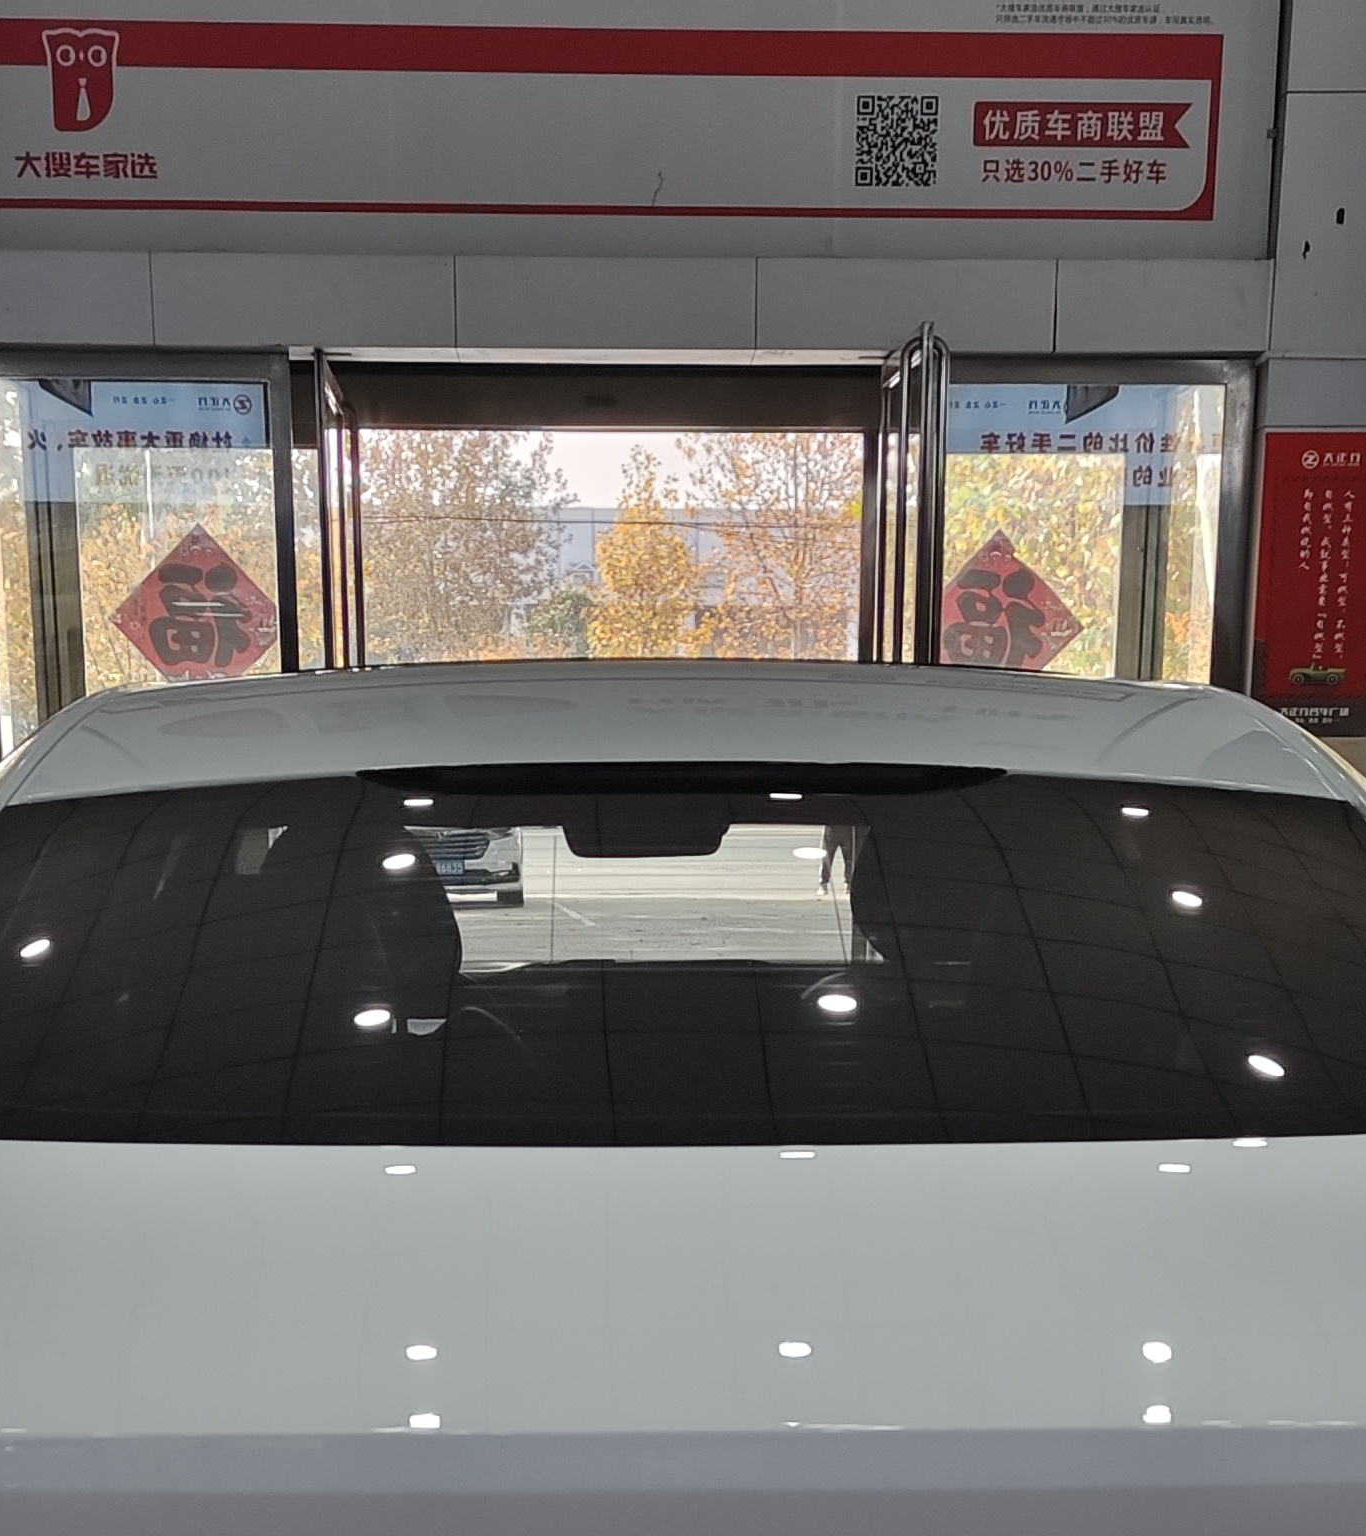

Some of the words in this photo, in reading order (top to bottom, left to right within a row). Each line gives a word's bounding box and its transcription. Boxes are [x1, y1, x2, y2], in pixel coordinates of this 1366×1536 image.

[982, 109, 1165, 141] 优质车商联盟
[14, 151, 159, 180] 大搜车家选
[981, 158, 1168, 185] 只选30%二手好车
